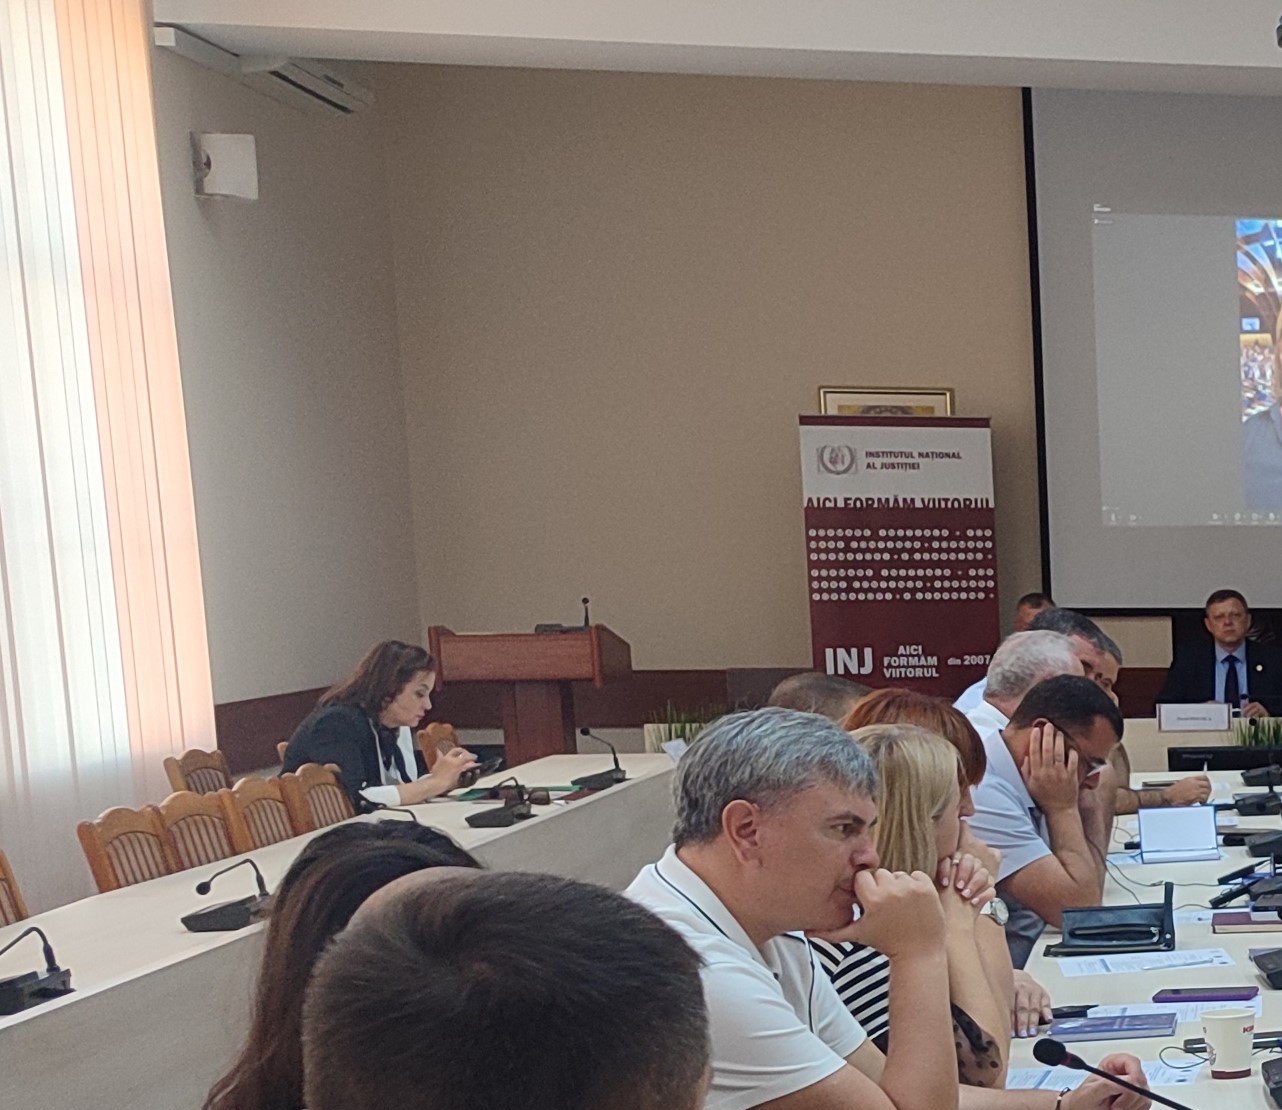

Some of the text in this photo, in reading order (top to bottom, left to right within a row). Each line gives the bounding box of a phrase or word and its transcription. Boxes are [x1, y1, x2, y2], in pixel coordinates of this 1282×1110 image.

[865, 451, 962, 461] INSTITUTUL NAȚIONAL
[898, 645, 922, 656] AICI
[825, 647, 873, 676] INJ
[883, 656, 938, 667] FORMĂM
[963, 655, 990, 666] 2007
[883, 667, 939, 678] VIITORUL
